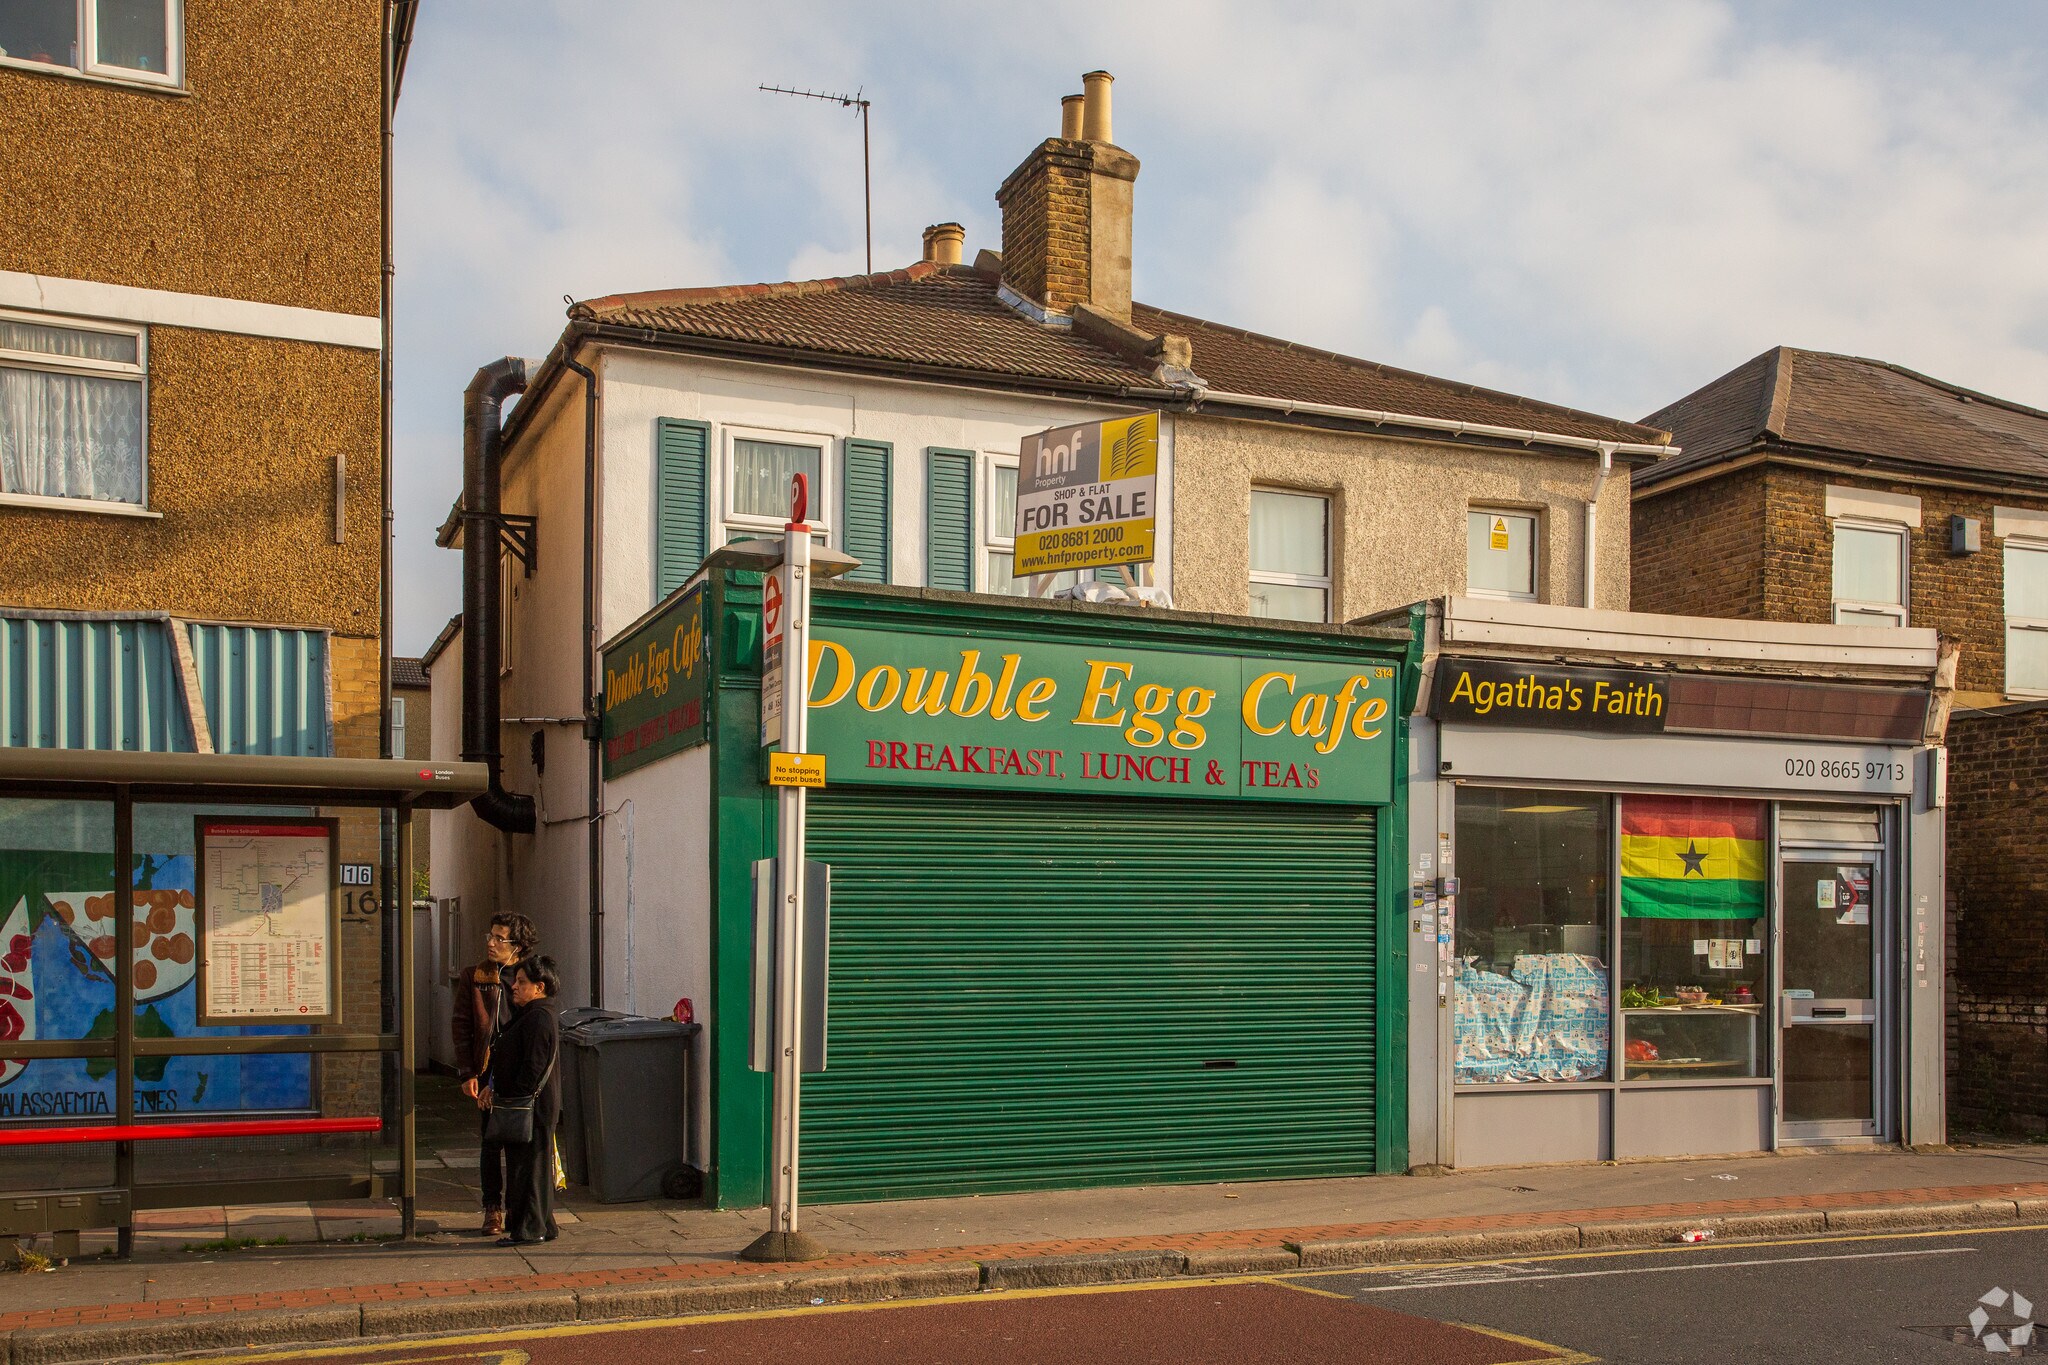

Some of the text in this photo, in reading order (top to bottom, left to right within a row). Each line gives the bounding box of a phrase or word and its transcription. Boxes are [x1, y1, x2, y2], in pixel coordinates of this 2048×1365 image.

[1036, 430, 1082, 478] hnf
[1035, 476, 1066, 488] Property
[1054, 484, 1111, 500] SHOP & FLAT
[1023, 491, 1146, 532] FOR SALE
[1039, 526, 1124, 550] 020 8681 2000
[1022, 544, 1144, 567] www.hnfproperty.com
[606, 613, 701, 712] Double Egg Cafe
[1374, 667, 1393, 679] 314
[806, 639, 1387, 754] Double Egg Cafe
[1449, 671, 1663, 717] Agatha's Faith
[788, 767, 820, 776] stopping
[865, 740, 1066, 780] BREAKFAST,
[1081, 751, 1192, 784] LUNCH
[1205, 759, 1226, 786] &
[1785, 758, 1904, 781] 020 8665 9713
[774, 775, 822, 784] except buses
[344, 891, 378, 915] 16
